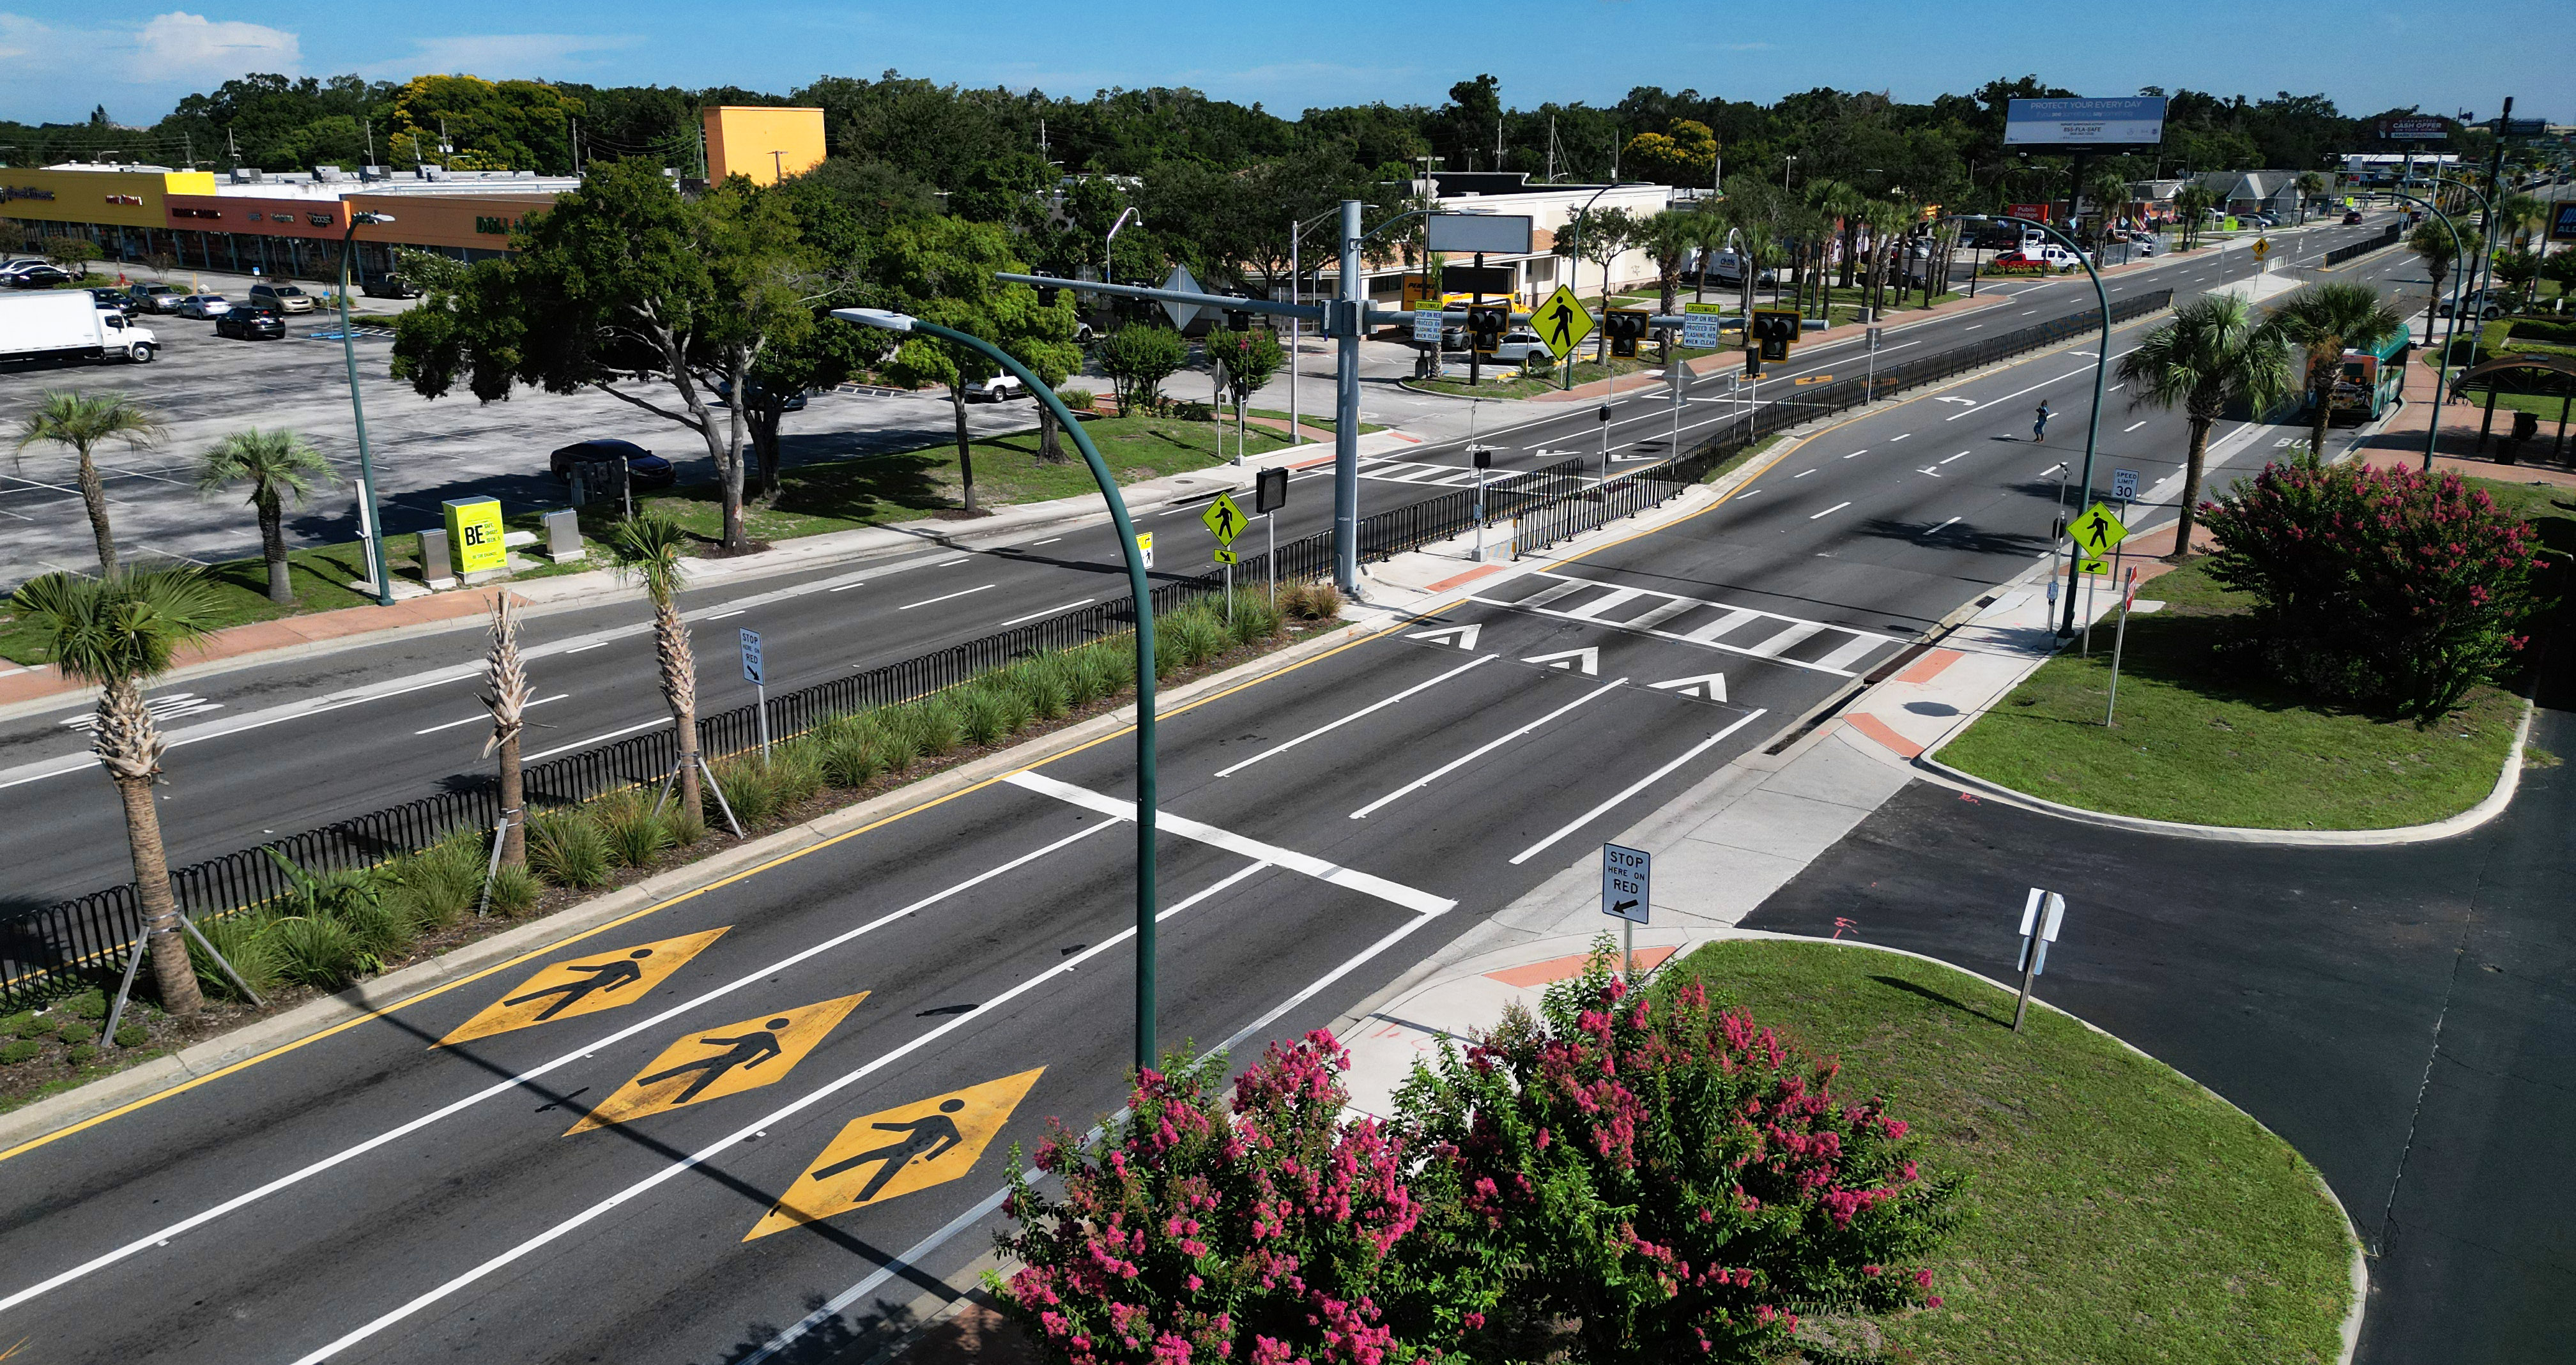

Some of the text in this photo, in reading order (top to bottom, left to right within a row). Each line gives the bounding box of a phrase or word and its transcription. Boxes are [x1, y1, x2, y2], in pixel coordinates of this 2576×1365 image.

[2095, 100, 2122, 109] EVERY
[2116, 485, 2133, 497] 30
[464, 525, 486, 546] BE
[742, 633, 758, 645] STOP
[746, 653, 758, 664] RED
[1610, 851, 1644, 868] STOP
[1608, 866, 1645, 881] HERE ON
[1613, 878, 1639, 894] RED
